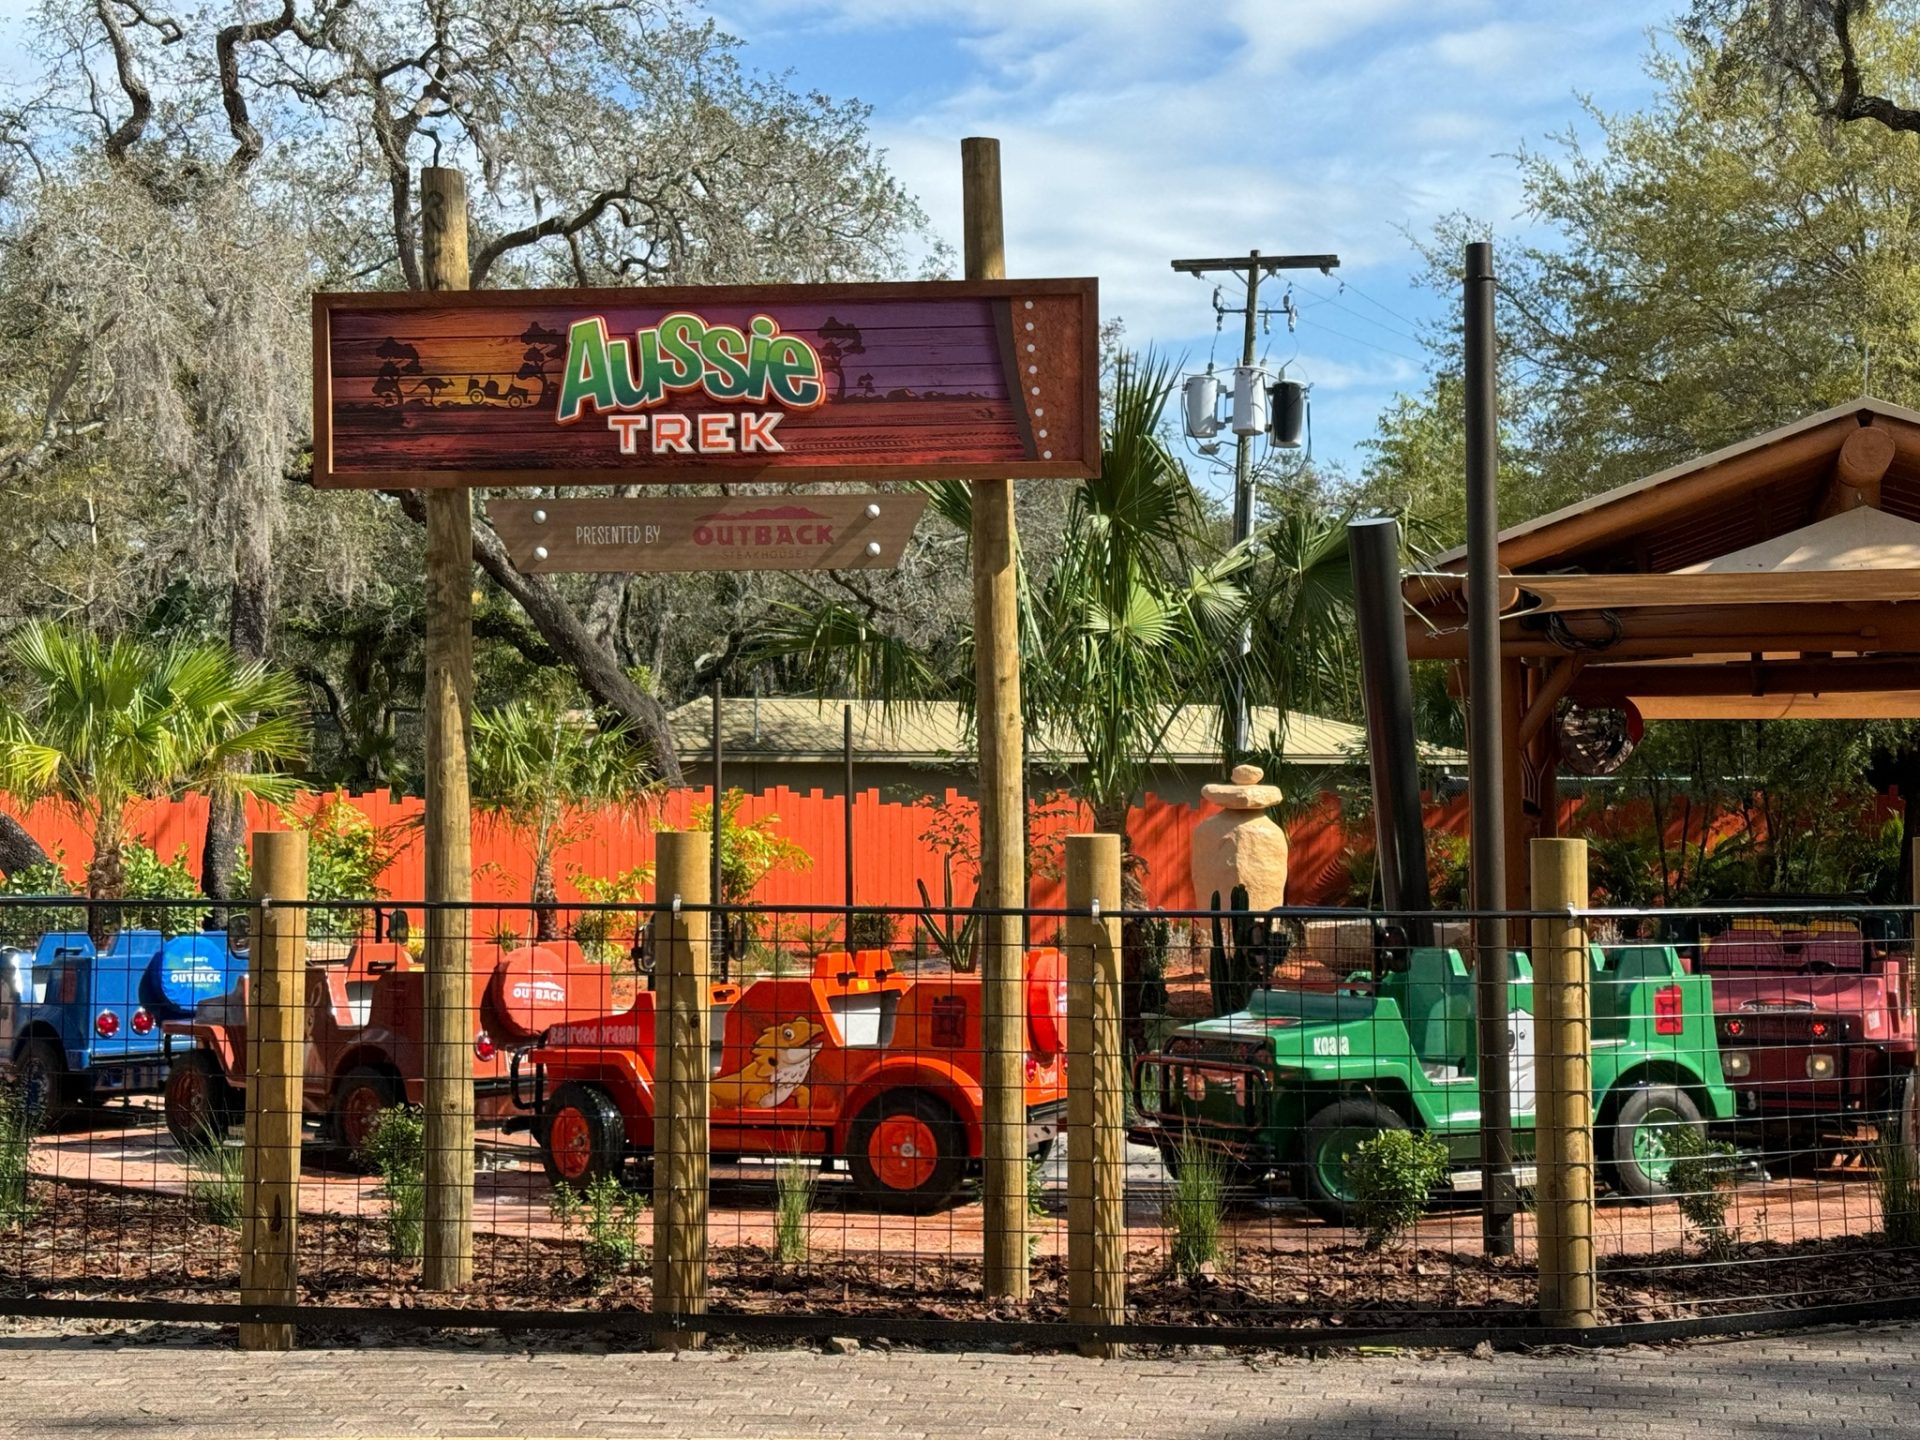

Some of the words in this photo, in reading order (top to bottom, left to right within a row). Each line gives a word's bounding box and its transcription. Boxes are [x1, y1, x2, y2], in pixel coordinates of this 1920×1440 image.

[557, 312, 822, 424] Aussie
[608, 412, 785, 454] TREK
[575, 525, 641, 545] PRESENTED
[645, 525, 661, 544] BY
[692, 524, 835, 547] OUTBACK
[721, 550, 802, 560] STEAKHOUSE
